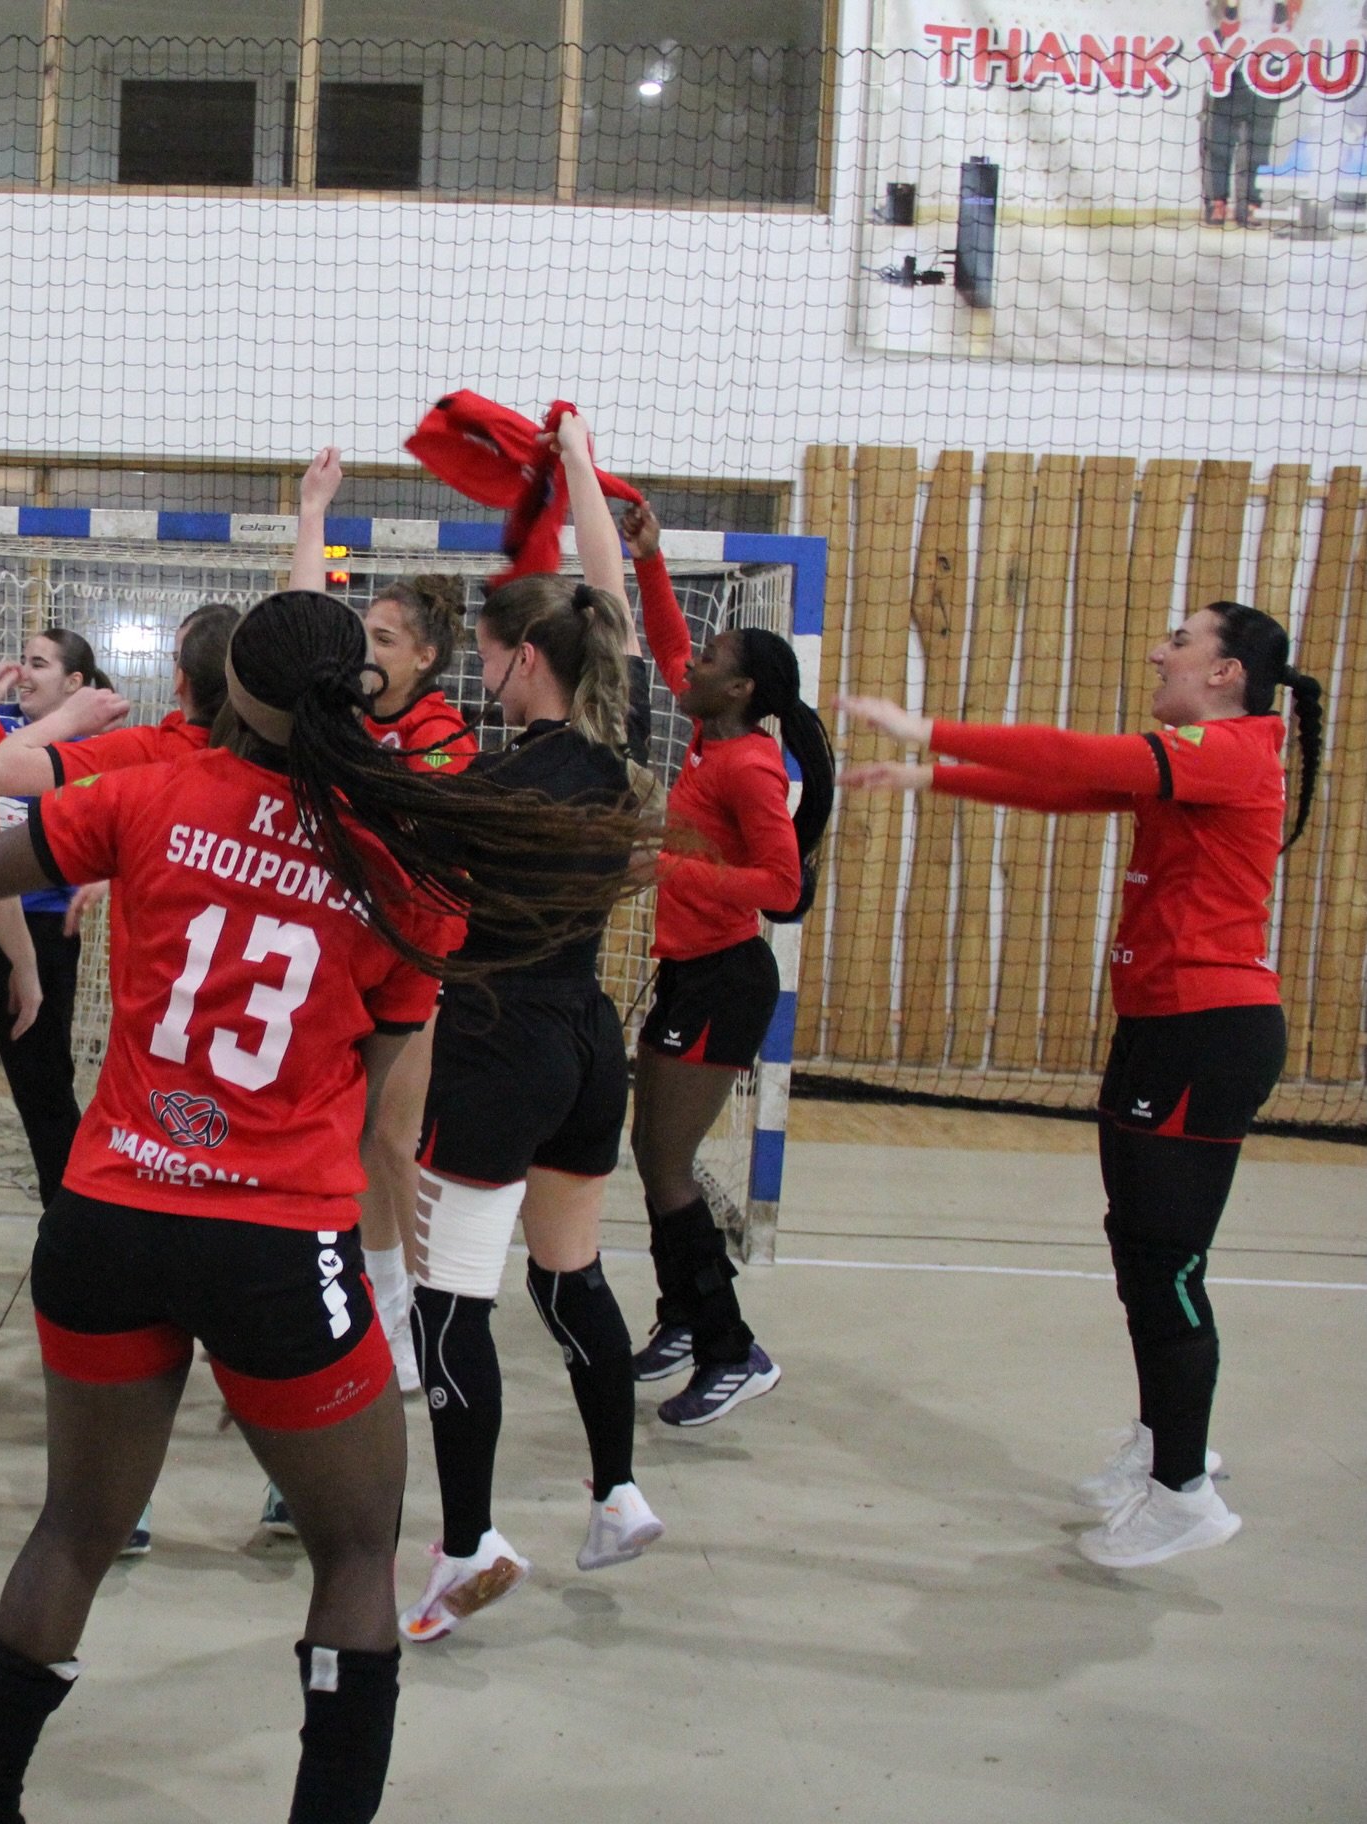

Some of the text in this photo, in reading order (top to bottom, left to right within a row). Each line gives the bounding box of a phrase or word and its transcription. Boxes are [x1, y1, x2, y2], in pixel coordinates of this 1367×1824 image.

[923, 23, 1361, 98] THANK YOU
[240, 522, 286, 532] elan
[149, 903, 322, 1092] 13
